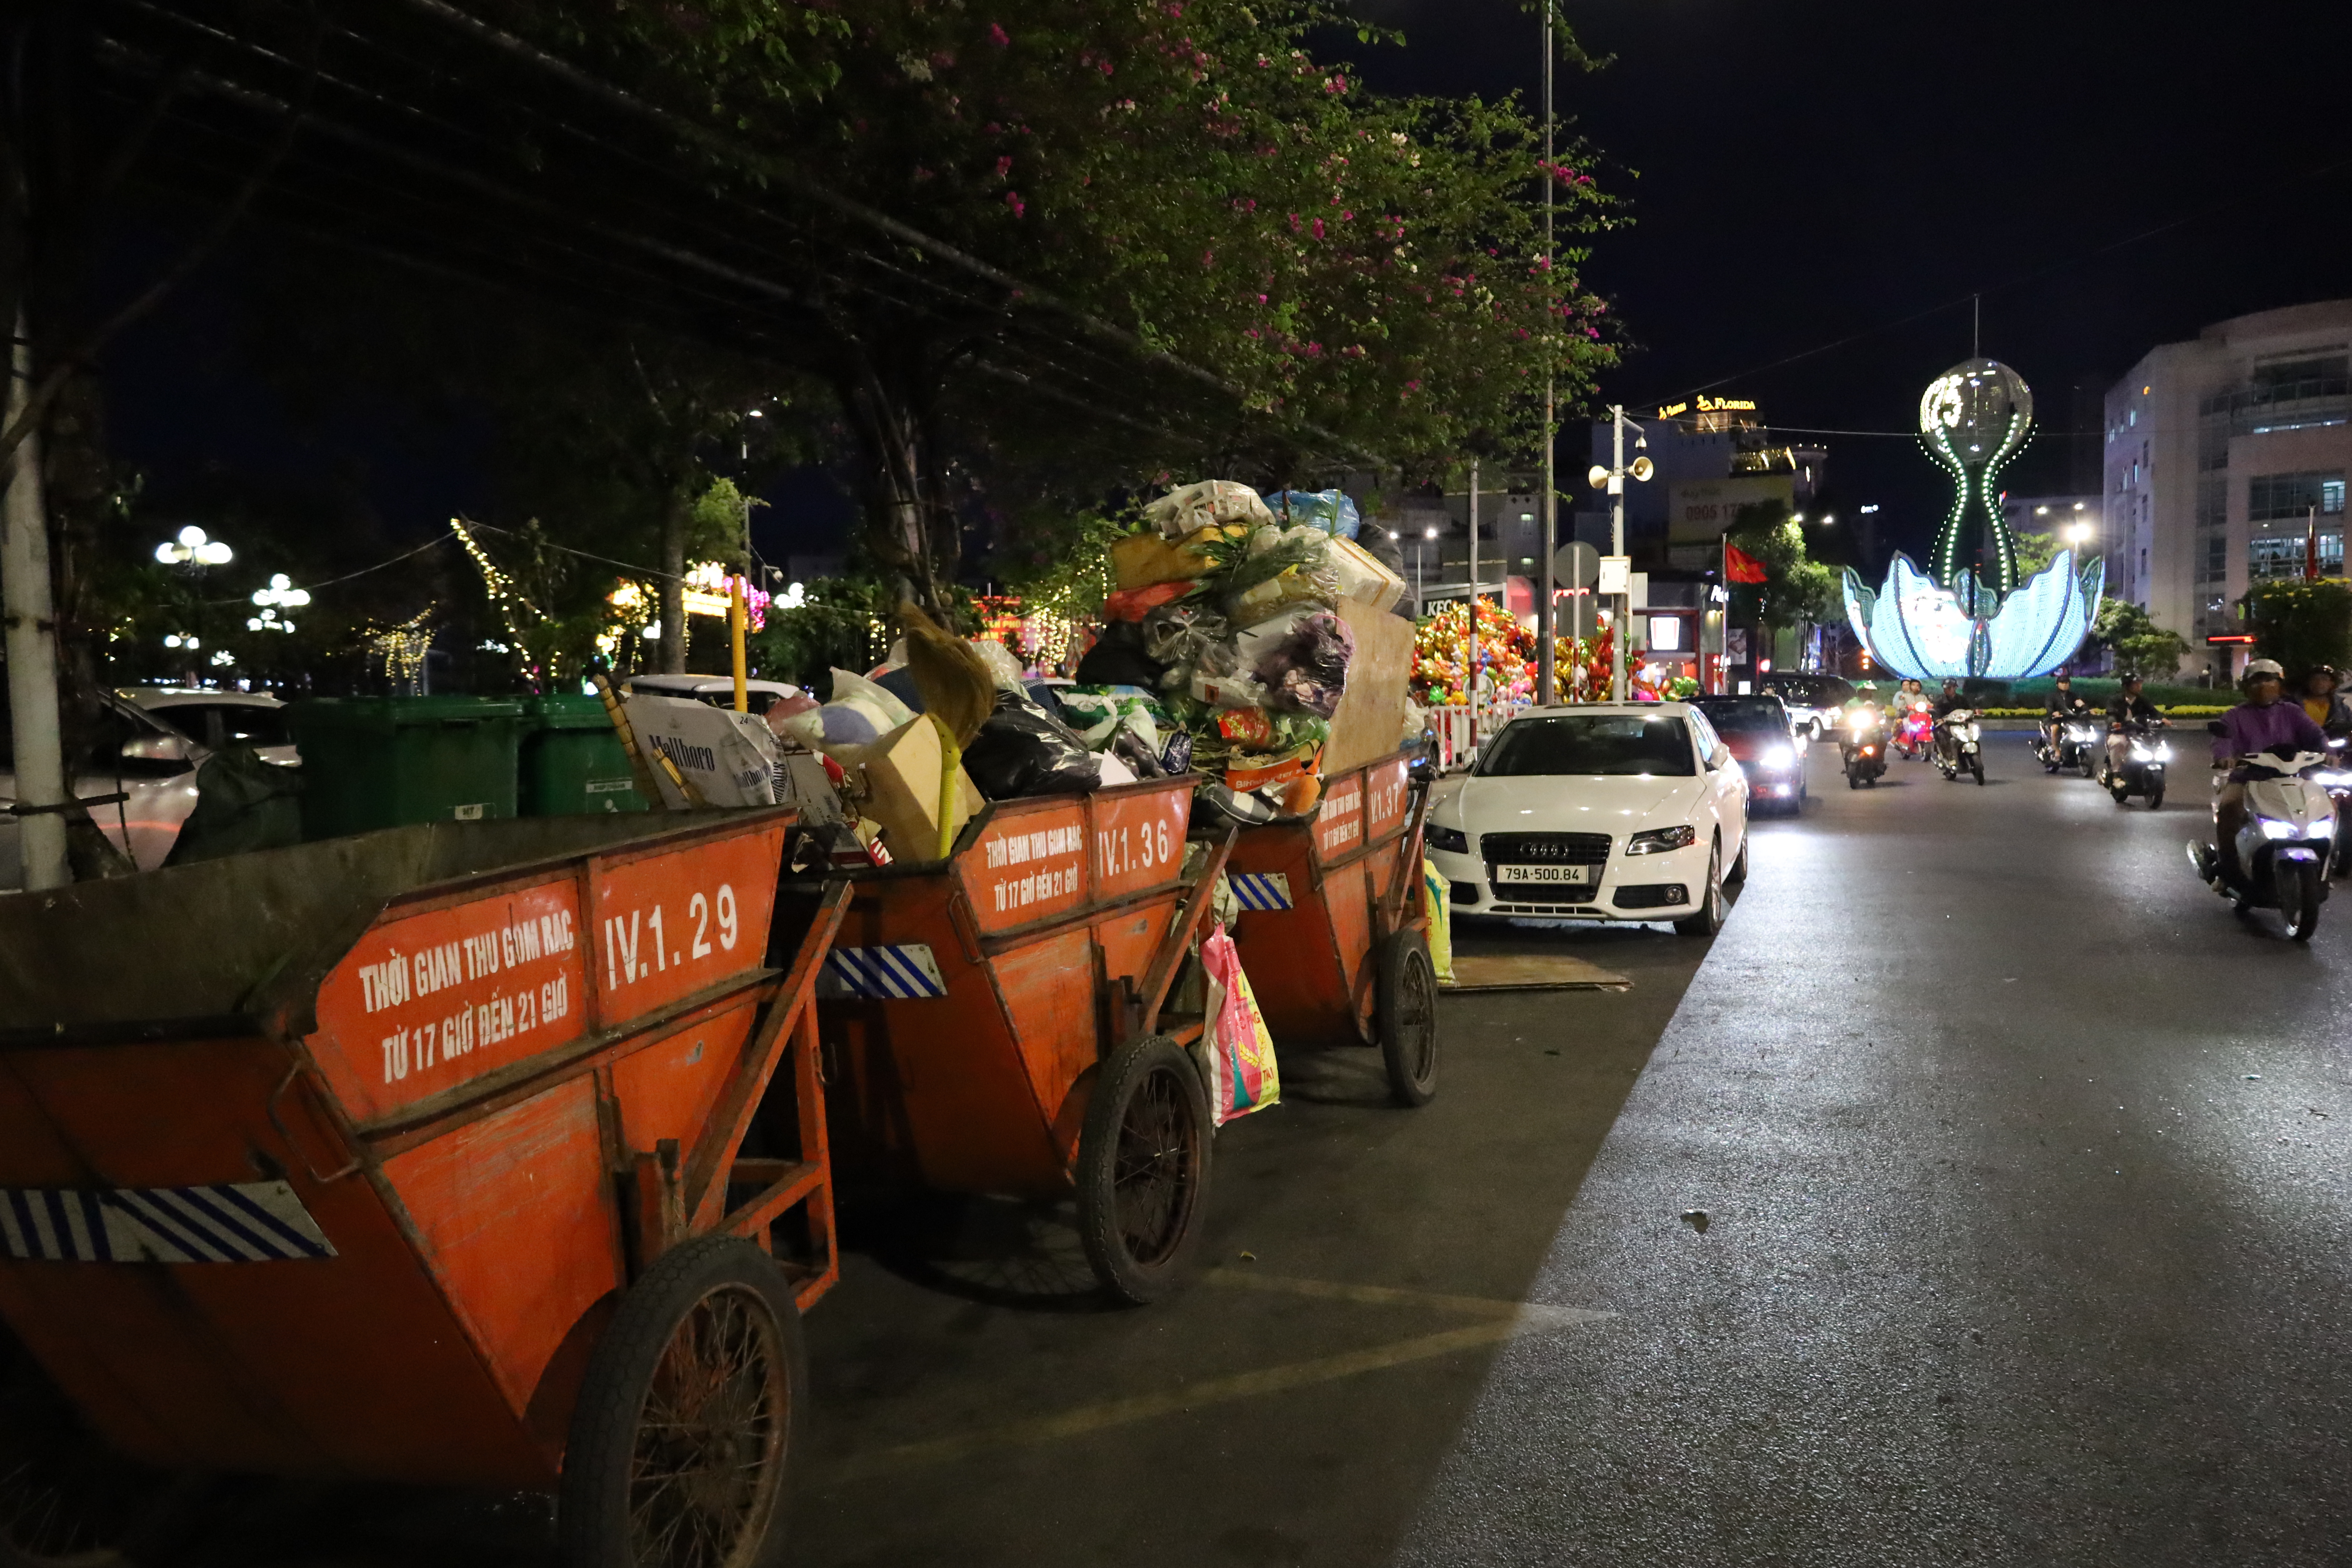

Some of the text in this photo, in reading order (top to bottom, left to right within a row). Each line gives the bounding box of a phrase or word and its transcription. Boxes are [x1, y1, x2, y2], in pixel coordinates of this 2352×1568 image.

[1715, 398, 1755, 410] FLORIDA
[1427, 599, 1452, 616] KFC
[1008, 834, 1030, 865] GIAN
[1030, 831, 1047, 859] THU
[1047, 828, 1066, 856] GOM
[1008, 880, 1019, 909] 17
[1020, 870, 1035, 906] GIỜ
[1054, 871, 1063, 897] 21
[1505, 868, 1579, 880] 79A-500.84
[359, 948, 410, 1013] THỜI
[415, 941, 462, 997] GIAN
[463, 930, 499, 980] THU
[502, 918, 541, 969] GOM
[381, 967, 568, 1084] TỪ 17 GIỜ ĐẾN 21 GIỜ
